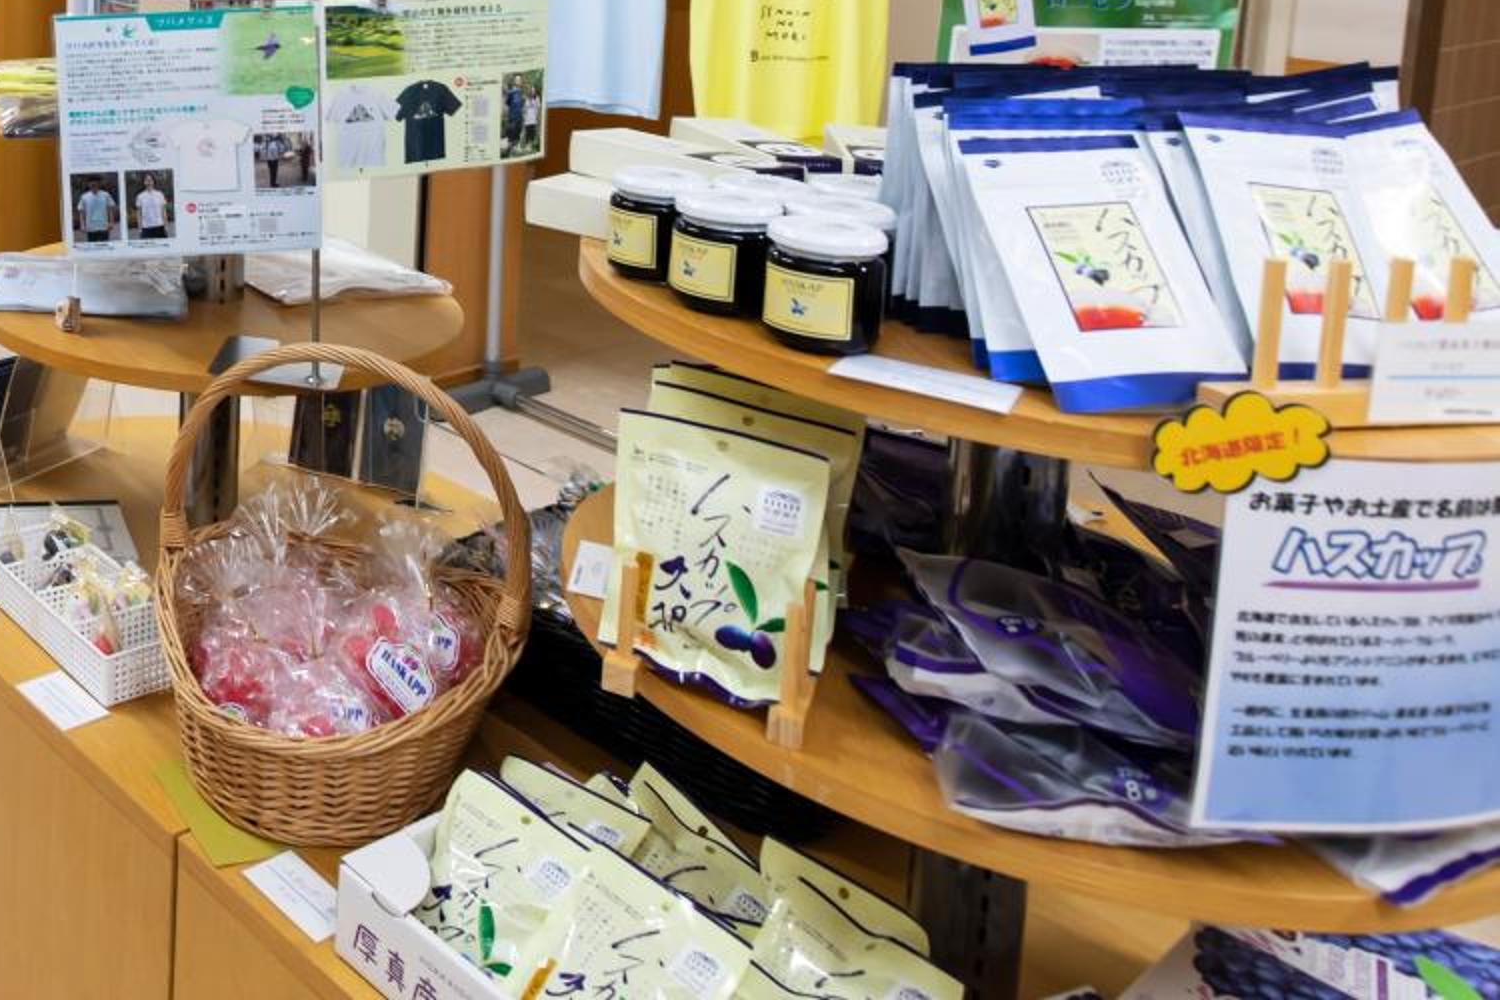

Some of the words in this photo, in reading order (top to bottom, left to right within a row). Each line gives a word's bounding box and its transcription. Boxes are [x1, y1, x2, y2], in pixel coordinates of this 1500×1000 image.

[1272, 526, 1487, 580] ハスカップ
[380, 648, 428, 698] HASKAPP
